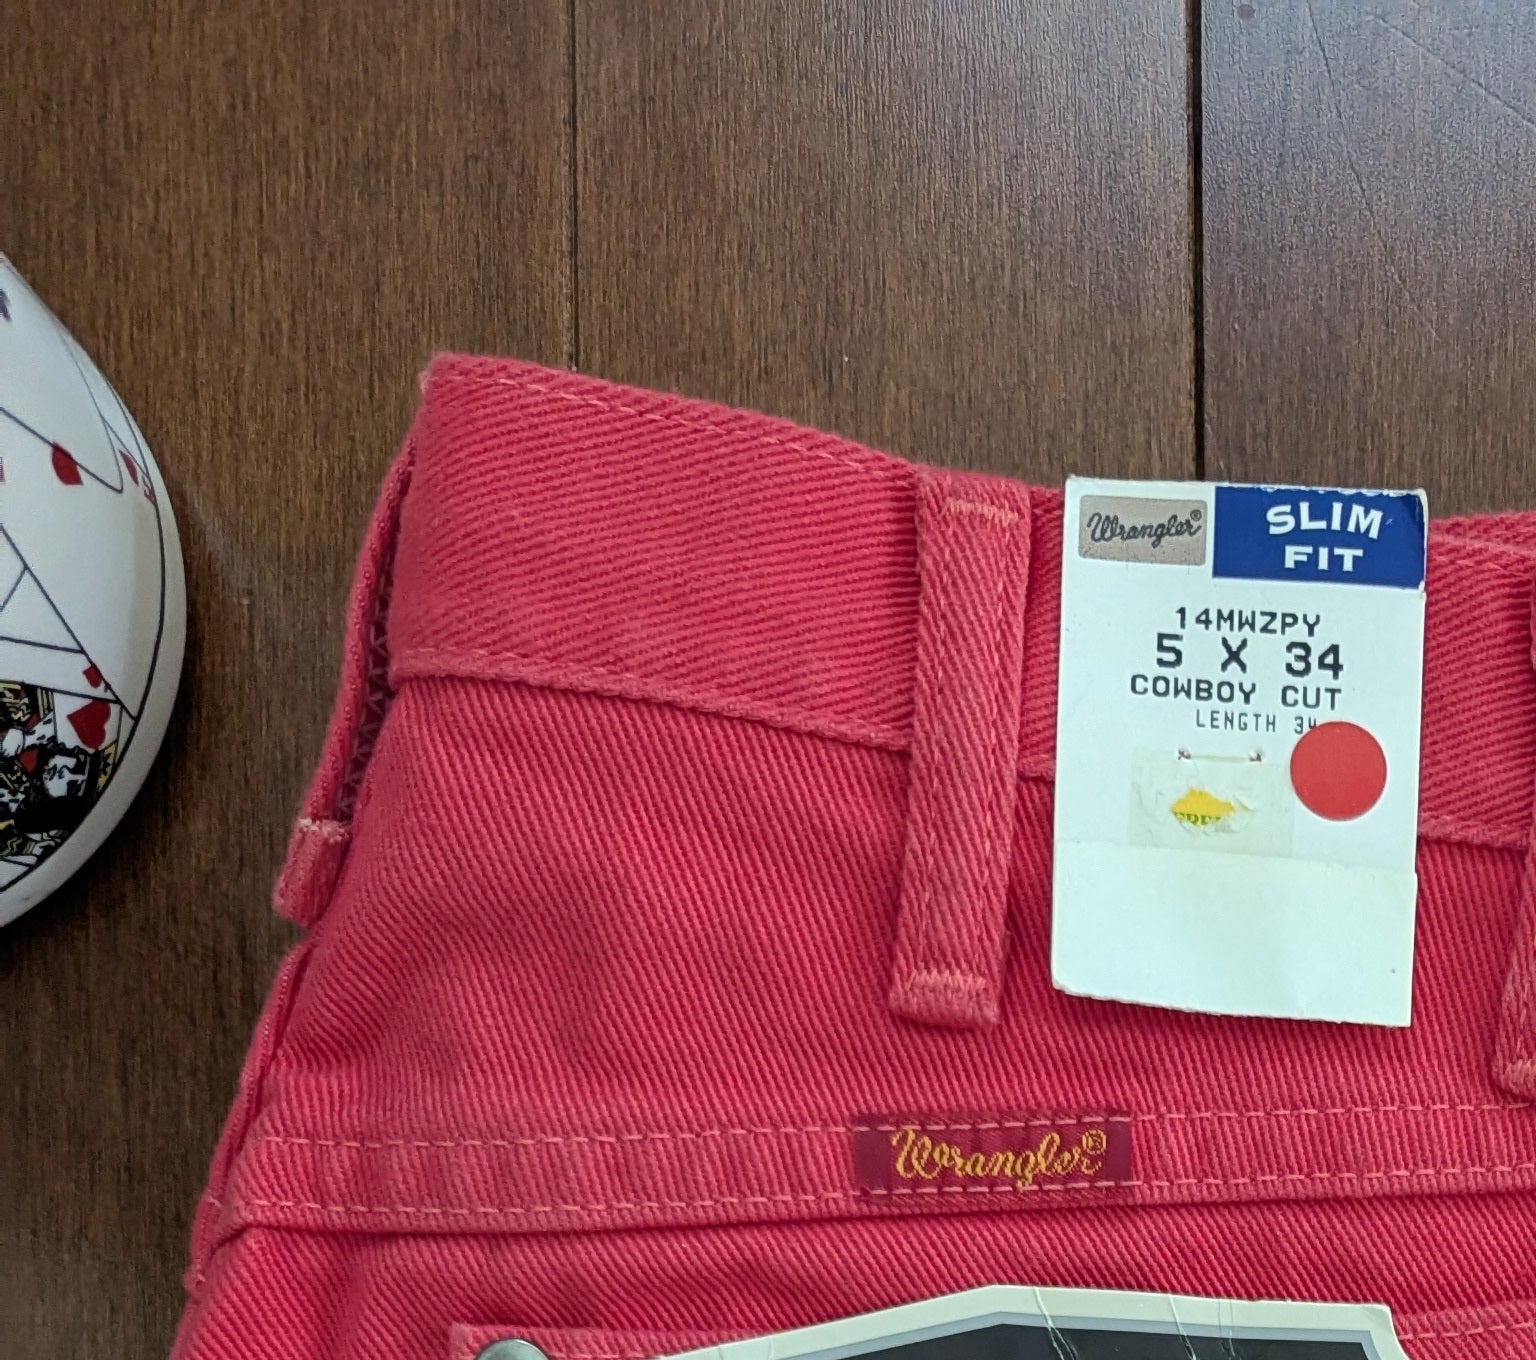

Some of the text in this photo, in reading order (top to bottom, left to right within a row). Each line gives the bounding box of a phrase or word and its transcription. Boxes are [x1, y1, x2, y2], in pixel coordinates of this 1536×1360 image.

[1266, 501, 1384, 540] SLIM
[1285, 546, 1363, 572] FIT
[1176, 606, 1321, 638] 14MWZPY
[1156, 632, 1344, 680] 5 X 34
[1130, 674, 1342, 711] COWBOY CUT
[1196, 708, 1276, 733] LENGTH
